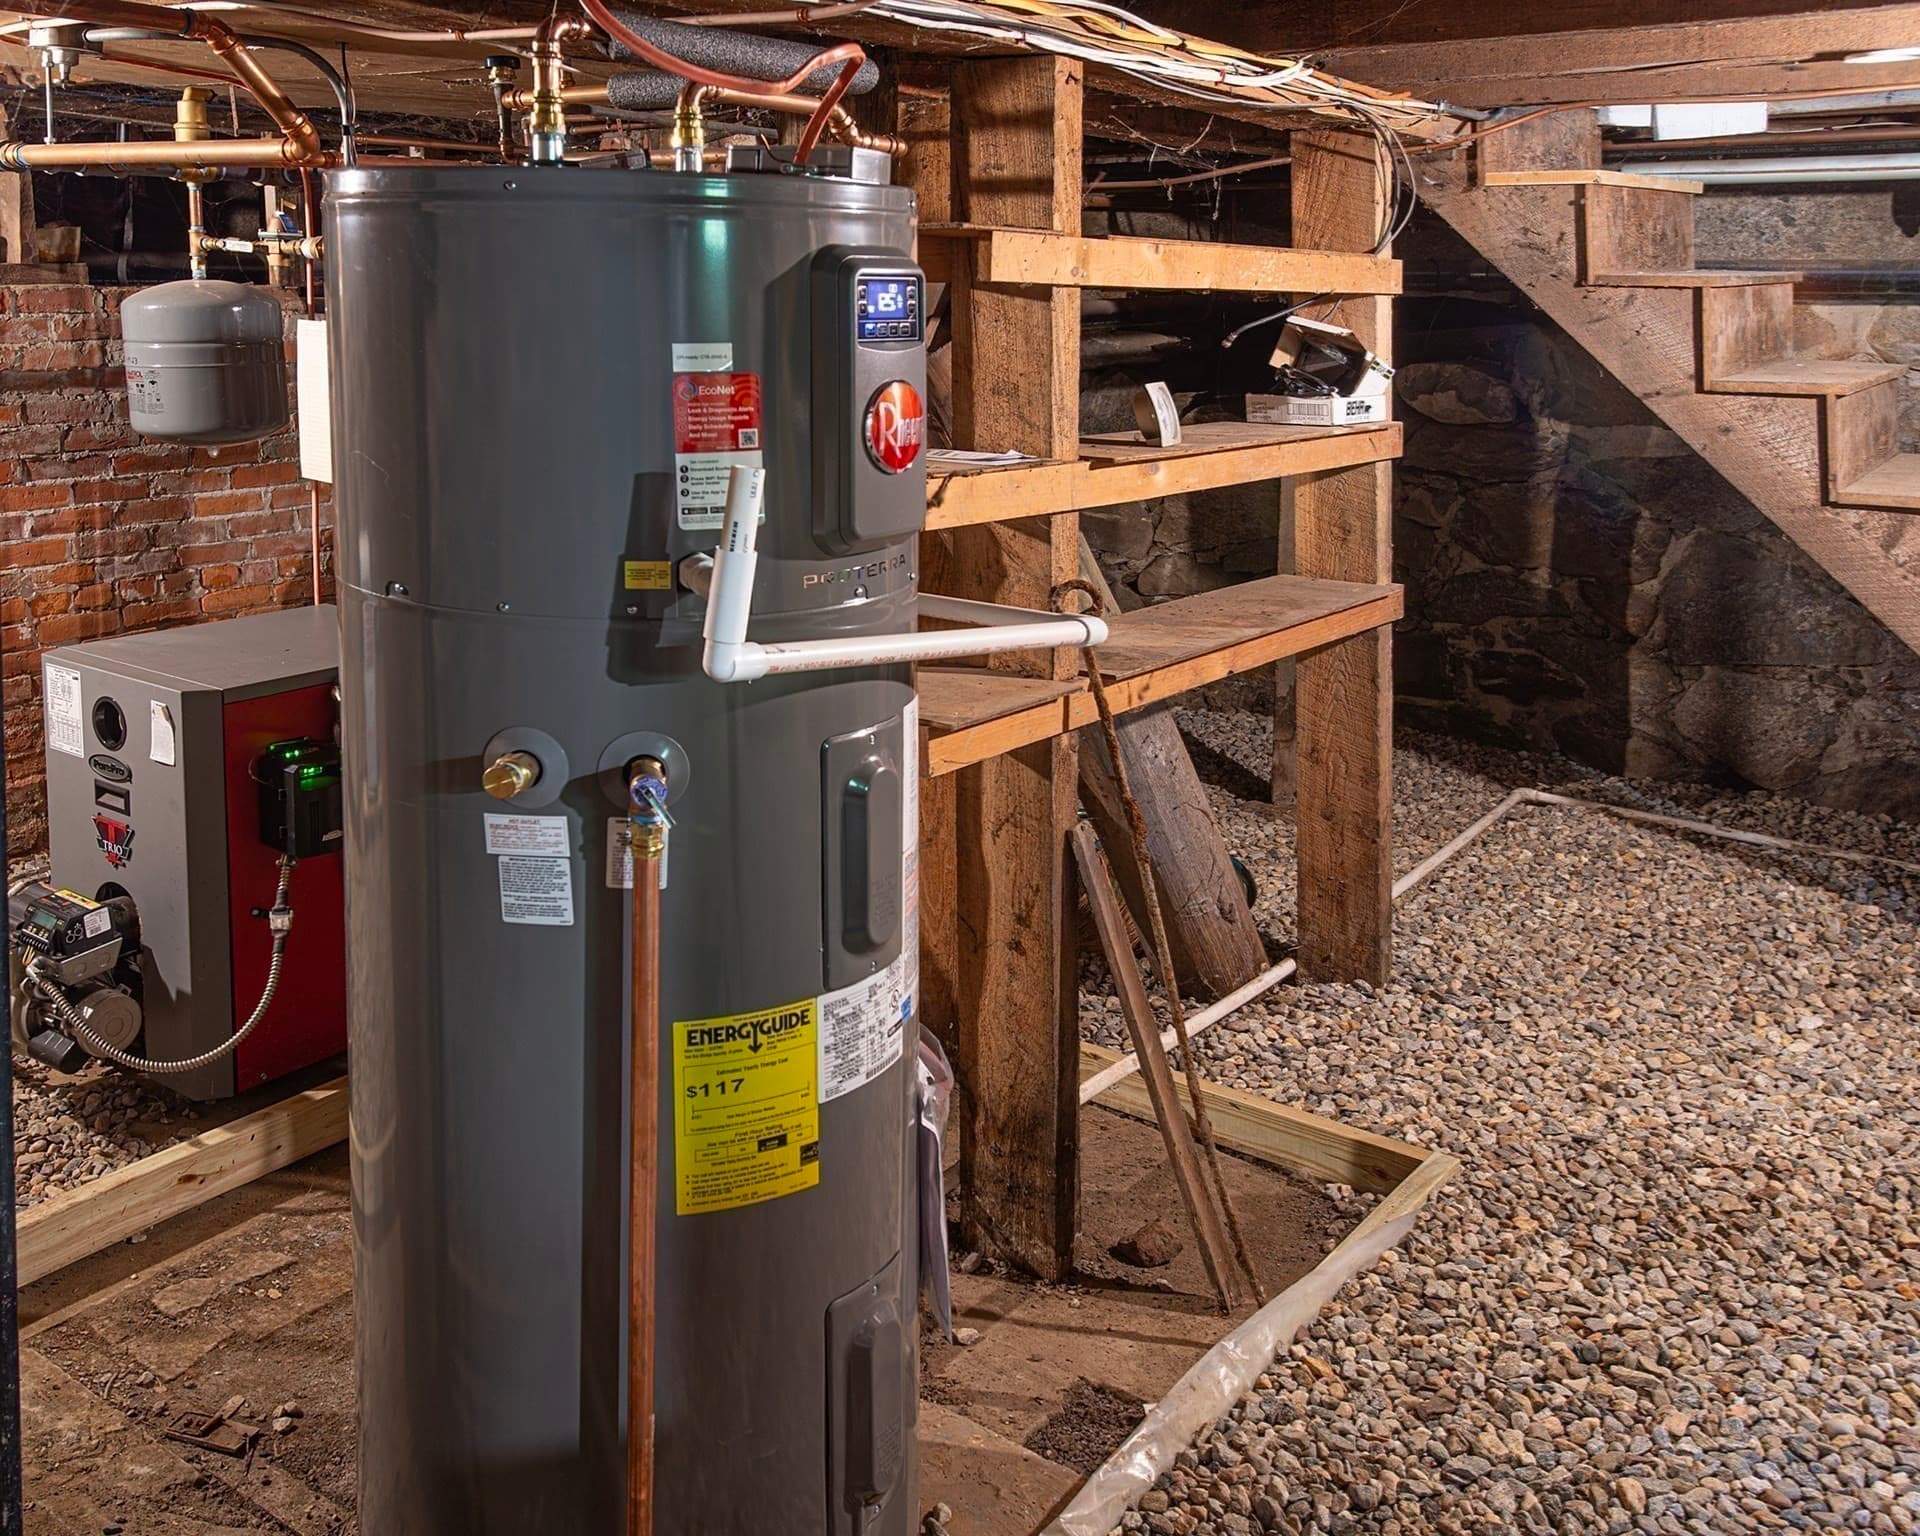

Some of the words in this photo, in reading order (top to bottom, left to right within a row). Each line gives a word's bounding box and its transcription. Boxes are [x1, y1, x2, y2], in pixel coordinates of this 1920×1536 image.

[698, 385, 735, 395] EcoNet
[1346, 400, 1365, 416] BEHR
[102, 839, 123, 855] TRIO
[686, 1008, 811, 1048] ENERGYGUIDE
[686, 1078, 745, 1098] $117
